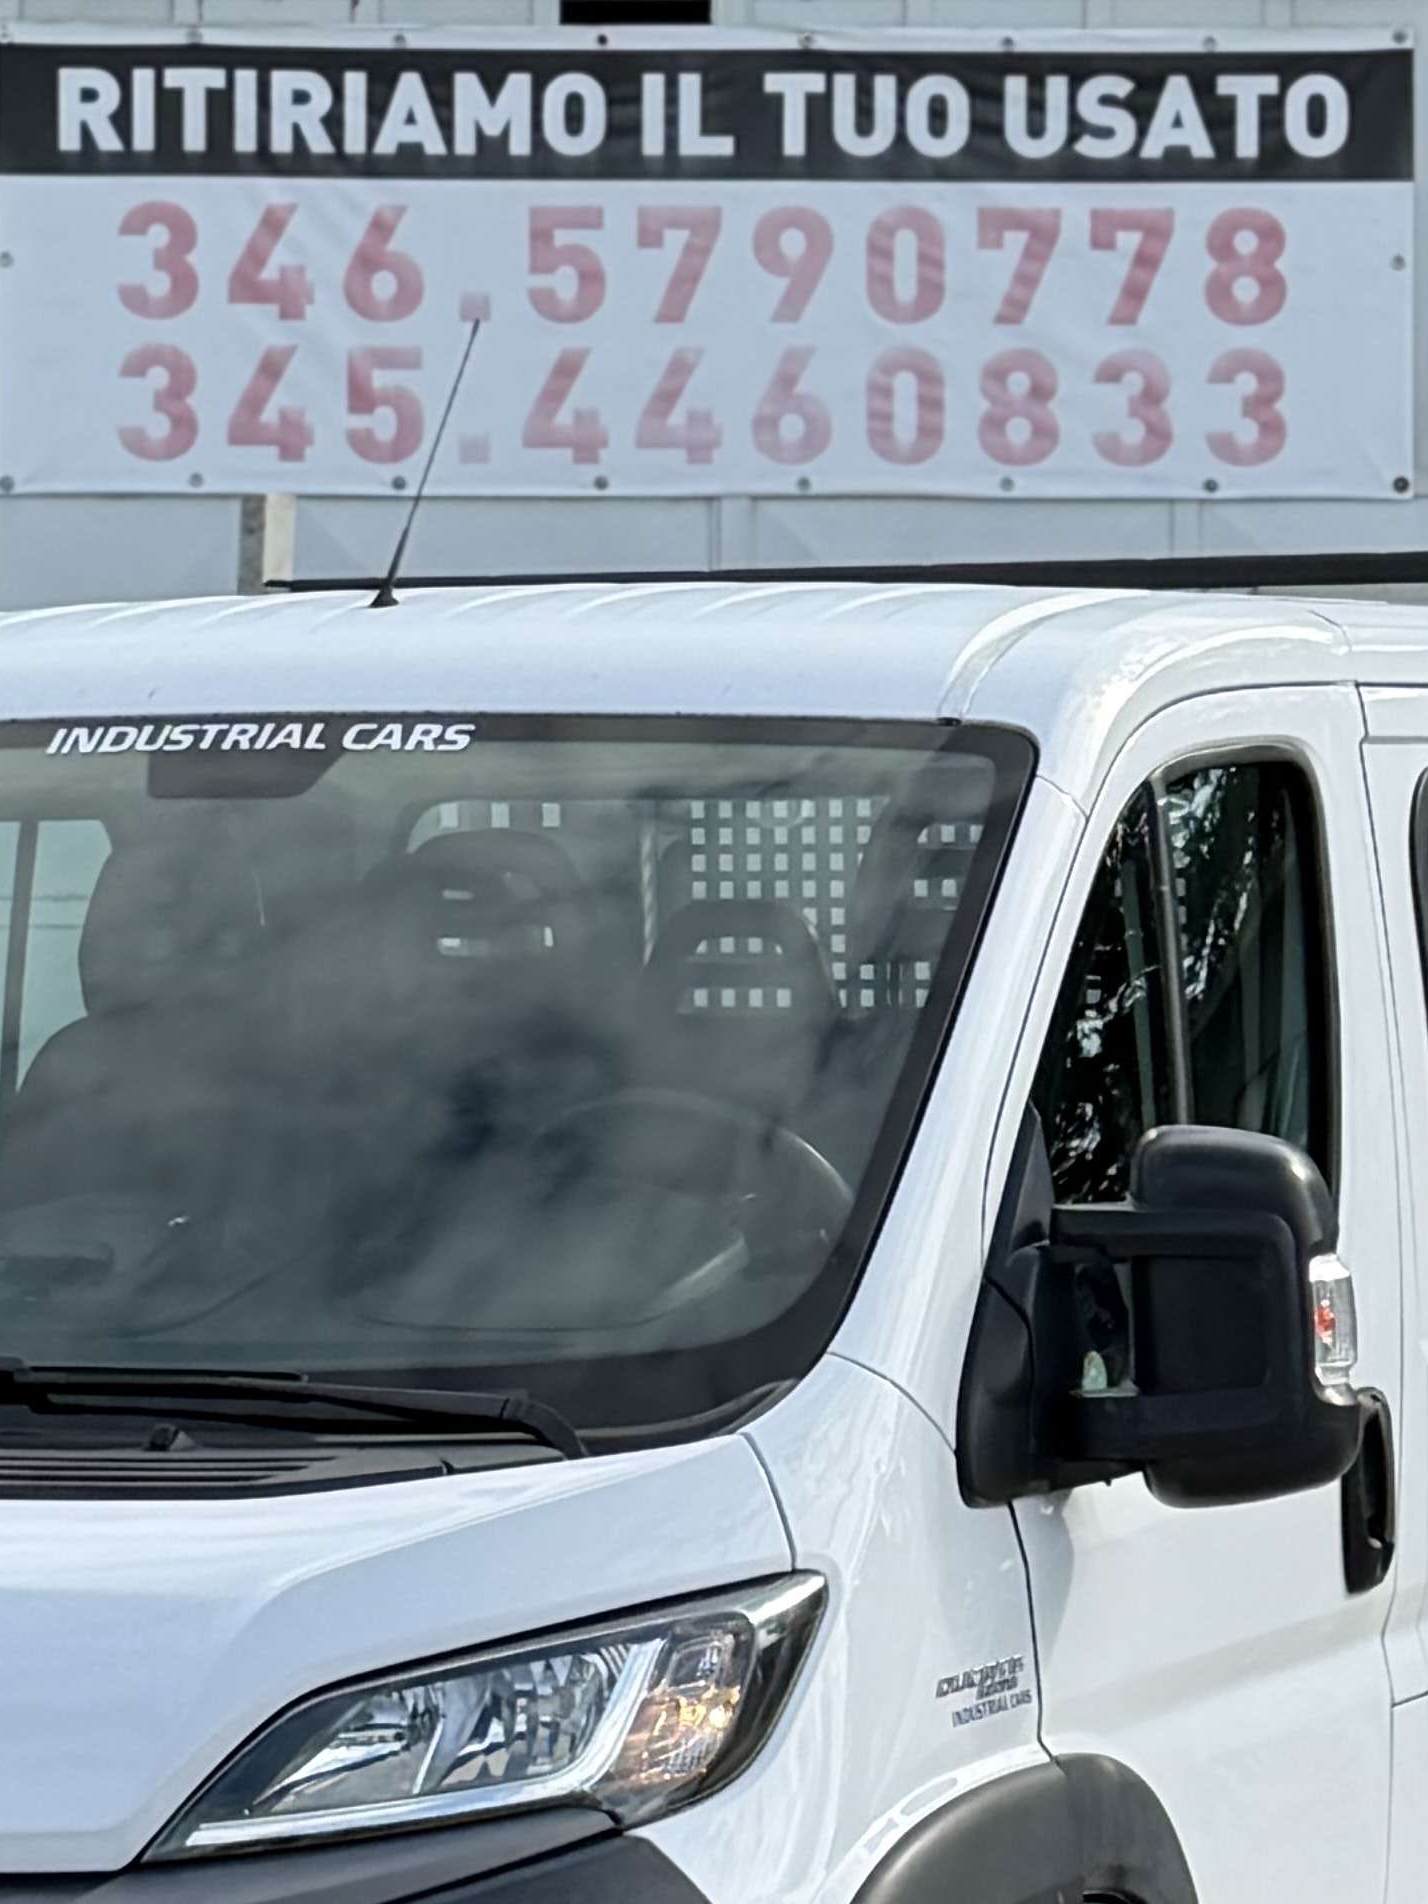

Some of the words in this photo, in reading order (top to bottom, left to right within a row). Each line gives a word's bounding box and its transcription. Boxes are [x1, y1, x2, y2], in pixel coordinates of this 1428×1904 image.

[56, 66, 608, 158] RITIRIAMO
[641, 71, 736, 158] IL
[763, 72, 972, 160] TUO
[1003, 73, 1351, 161] USATO
[45, 722, 327, 756] INDUSTRIAL
[341, 722, 477, 752] CARS
